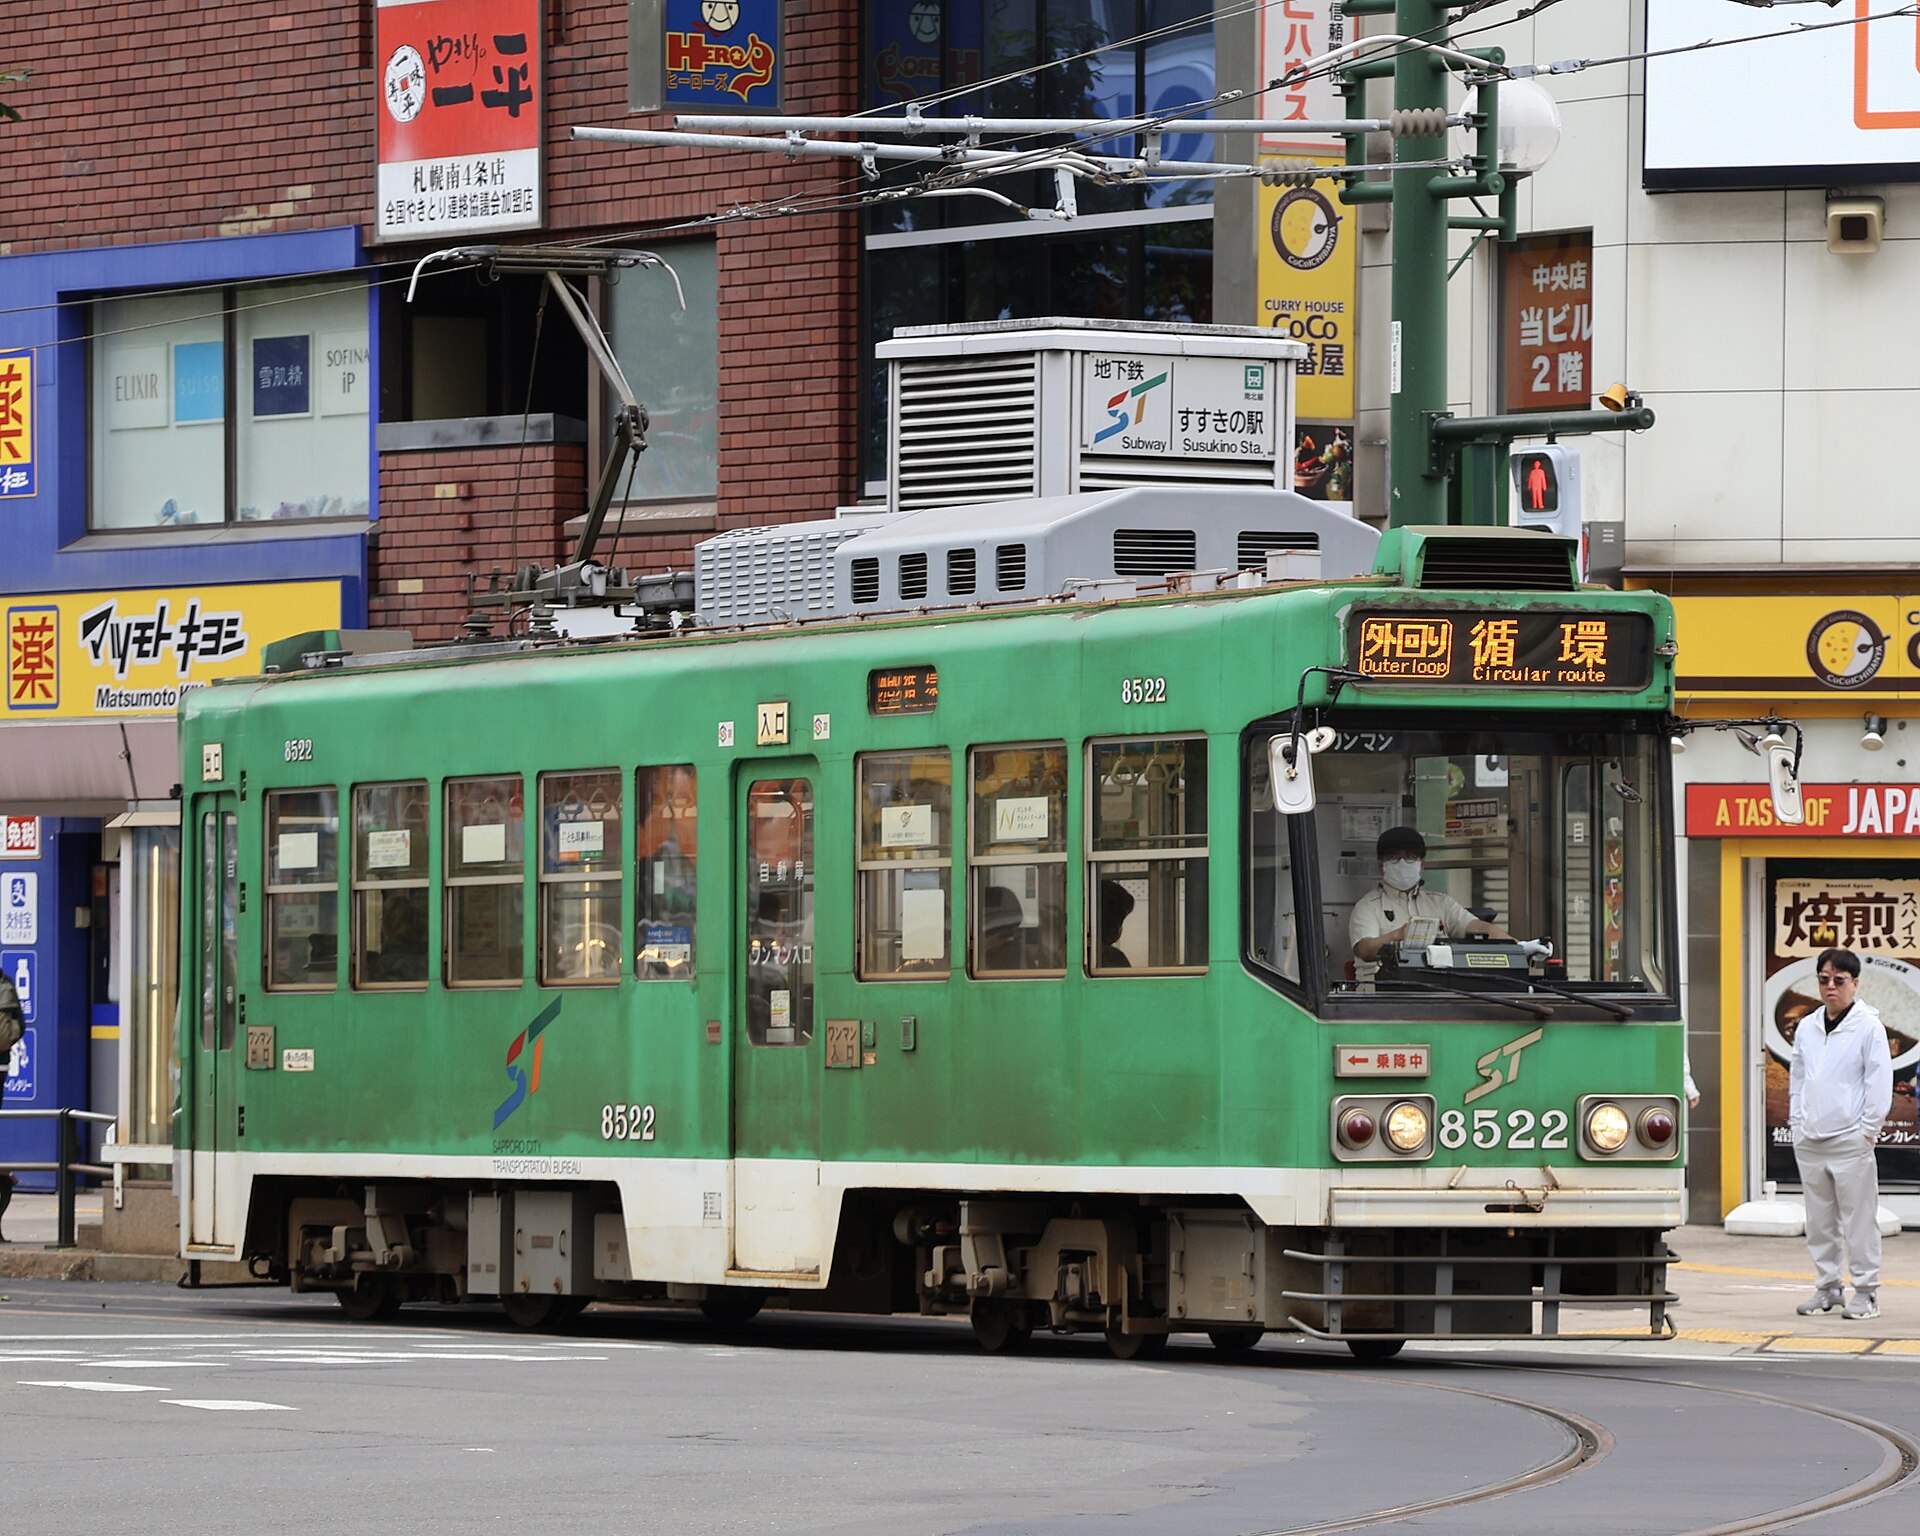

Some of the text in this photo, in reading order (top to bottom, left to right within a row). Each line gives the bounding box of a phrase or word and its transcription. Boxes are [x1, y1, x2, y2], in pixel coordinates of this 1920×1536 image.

[667, 72, 728, 91] ヒーローズ
[413, 158, 505, 194] 札幌南4条店
[385, 187, 534, 226] 全国やきとり連絡協議会加盟店
[1532, 259, 1588, 294] 中央店
[1265, 299, 1344, 313] CURRY HOUSE
[1272, 313, 1338, 339] CoCo
[1520, 303, 1592, 347] 当ビル
[259, 365, 303, 389] 雪肌精
[1094, 358, 1144, 381] 地下鉄
[1531, 351, 1584, 393] 2階
[115, 372, 159, 402] ELIXIR
[1177, 407, 1264, 434] すすきの駅
[1122, 435, 1167, 453] Subway
[1183, 438, 1264, 455] Susukino Sta.
[80, 604, 245, 674] マツモトキヨシ
[1365, 622, 1447, 658] 外回り
[12, 616, 55, 700] 薬
[1363, 659, 1606, 683] Outer loop Circular route
[96, 688, 176, 709] Matsumoto
[1121, 677, 1166, 704] 8522
[761, 713, 784, 737] 入口
[284, 738, 313, 762] 8522
[1715, 798, 1731, 826] A
[1804, 798, 1832, 826] OF
[8, 821, 36, 849] 免税
[1783, 891, 1900, 950] 焙煎
[1902, 892, 1918, 949] スパイス
[751, 945, 812, 966] ワンマン入口
[828, 1026, 857, 1041] ワンマン
[1376, 1053, 1423, 1069] 乗降中
[601, 1104, 656, 1141] 8522
[1439, 1109, 1569, 1149] 8522
[492, 1140, 541, 1154] SAPPORO CITY
[492, 1160, 581, 1175] TRANSPORTATION BUREAU
